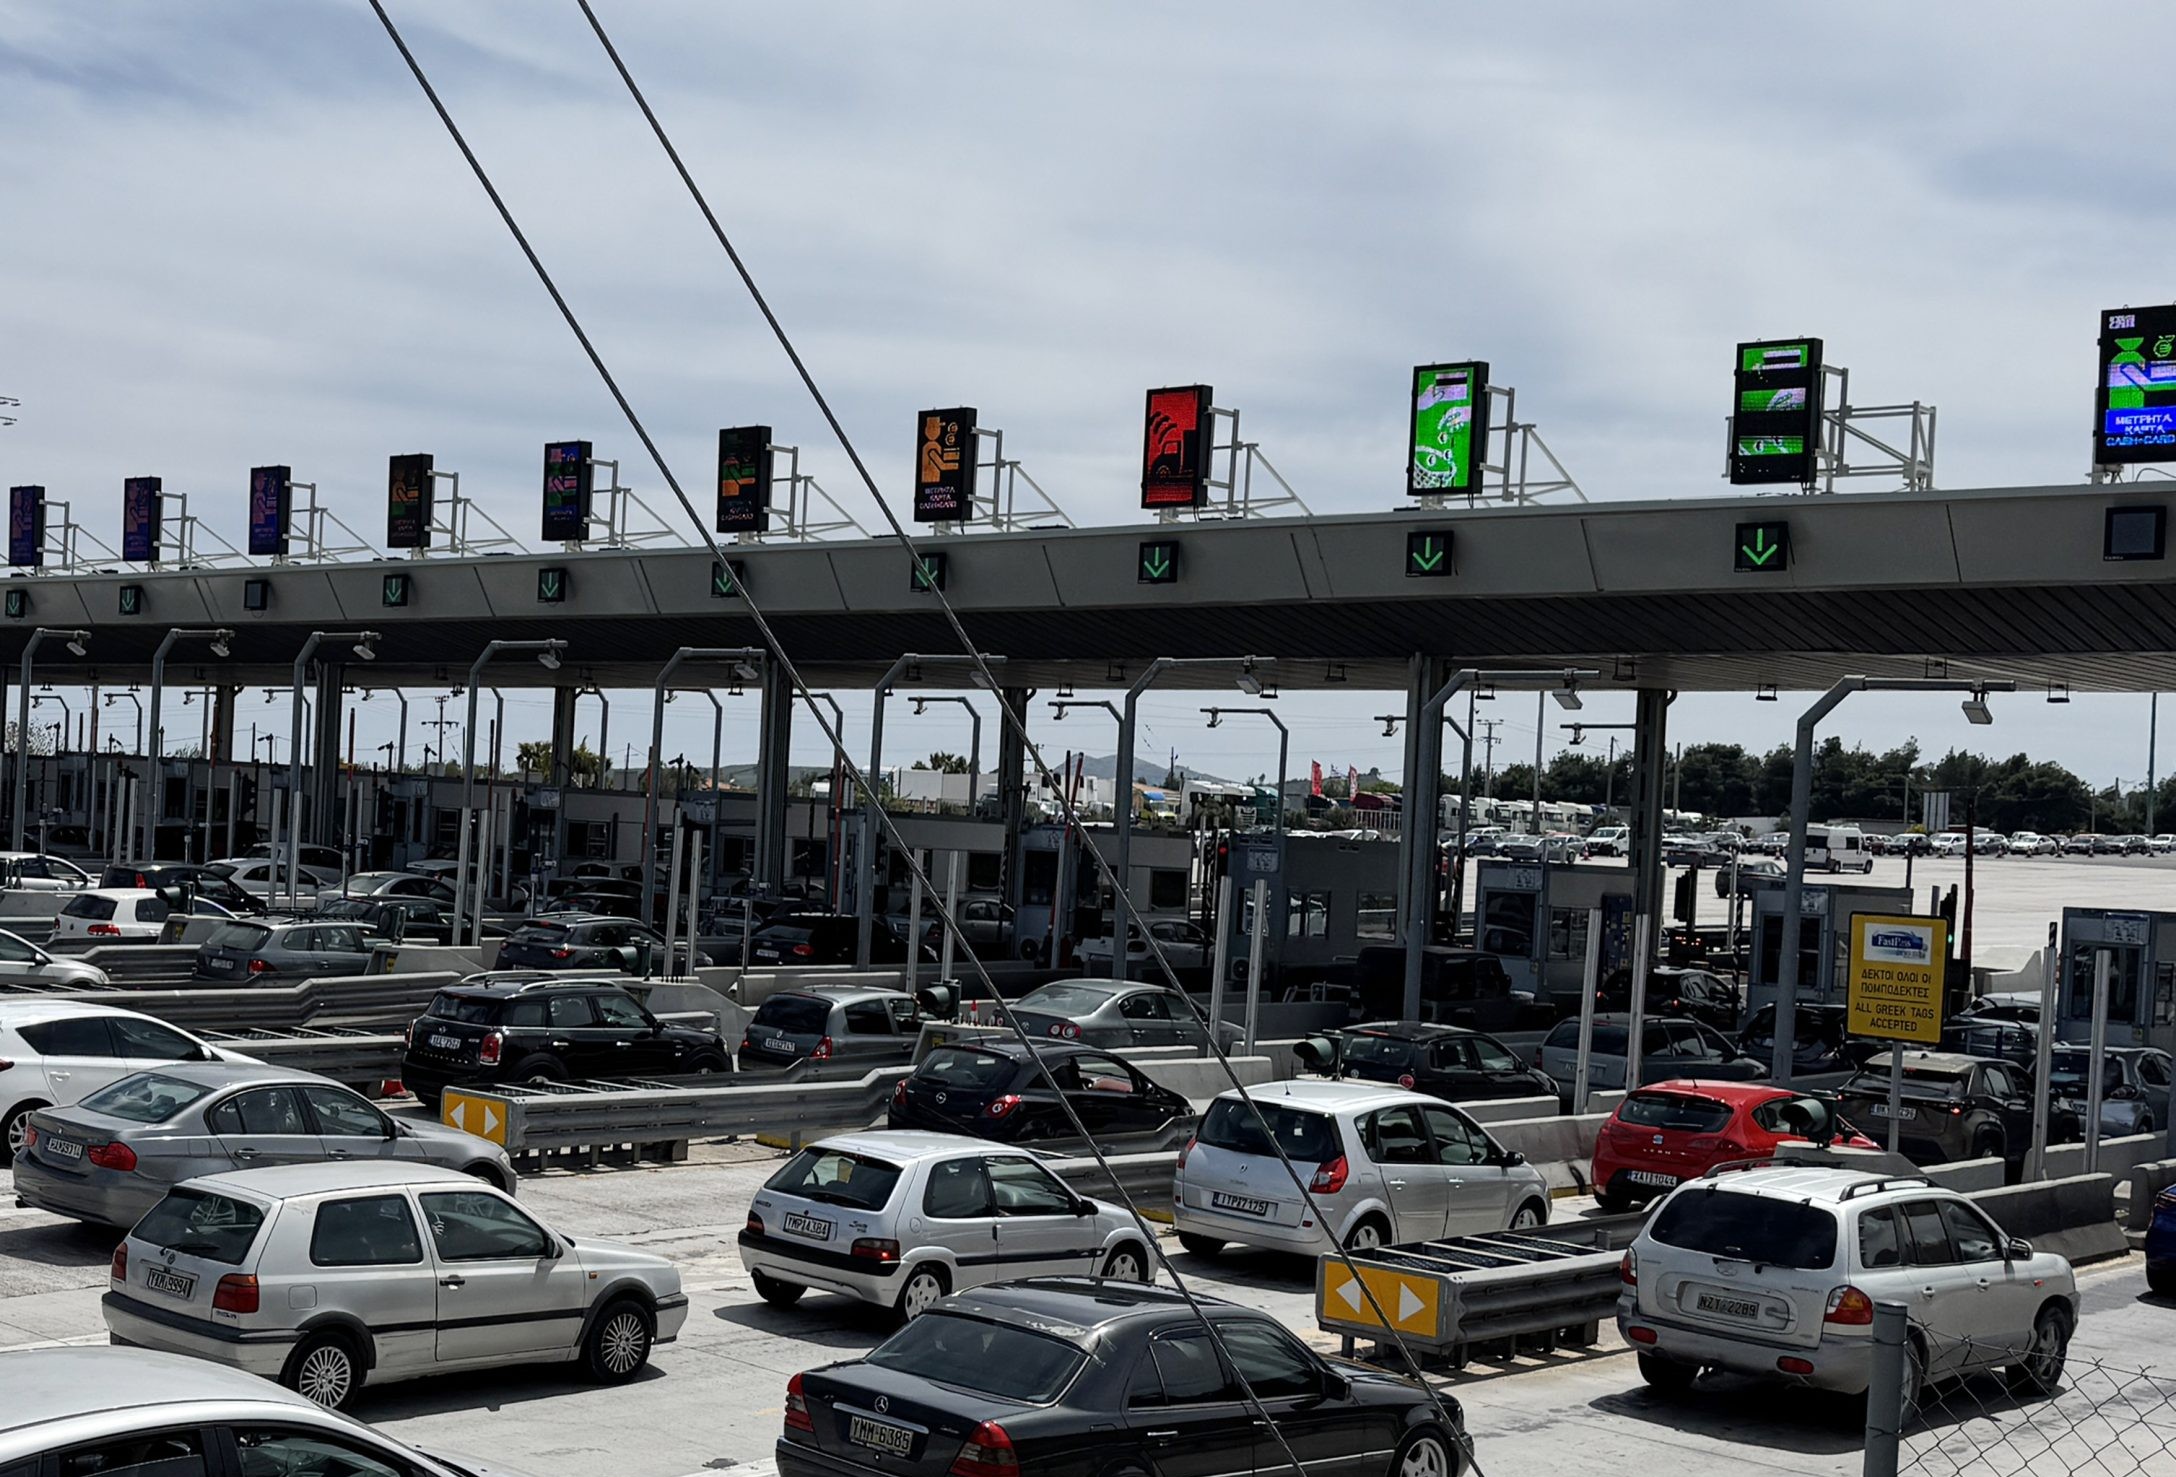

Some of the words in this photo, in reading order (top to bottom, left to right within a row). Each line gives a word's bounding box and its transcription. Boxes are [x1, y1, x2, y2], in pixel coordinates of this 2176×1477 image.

[1861, 968, 1894, 981] ΔΕΚΤΟΙ
[1897, 971, 1919, 983] ΟΛΟΙ
[1921, 974, 1931, 985] ΟΙ
[1855, 1001, 1872, 1013] ALL
[1875, 1003, 1906, 1017] GREEK
[1911, 1006, 1934, 1019] TAGS
[1869, 1018, 1917, 1032] ACCEPTED
